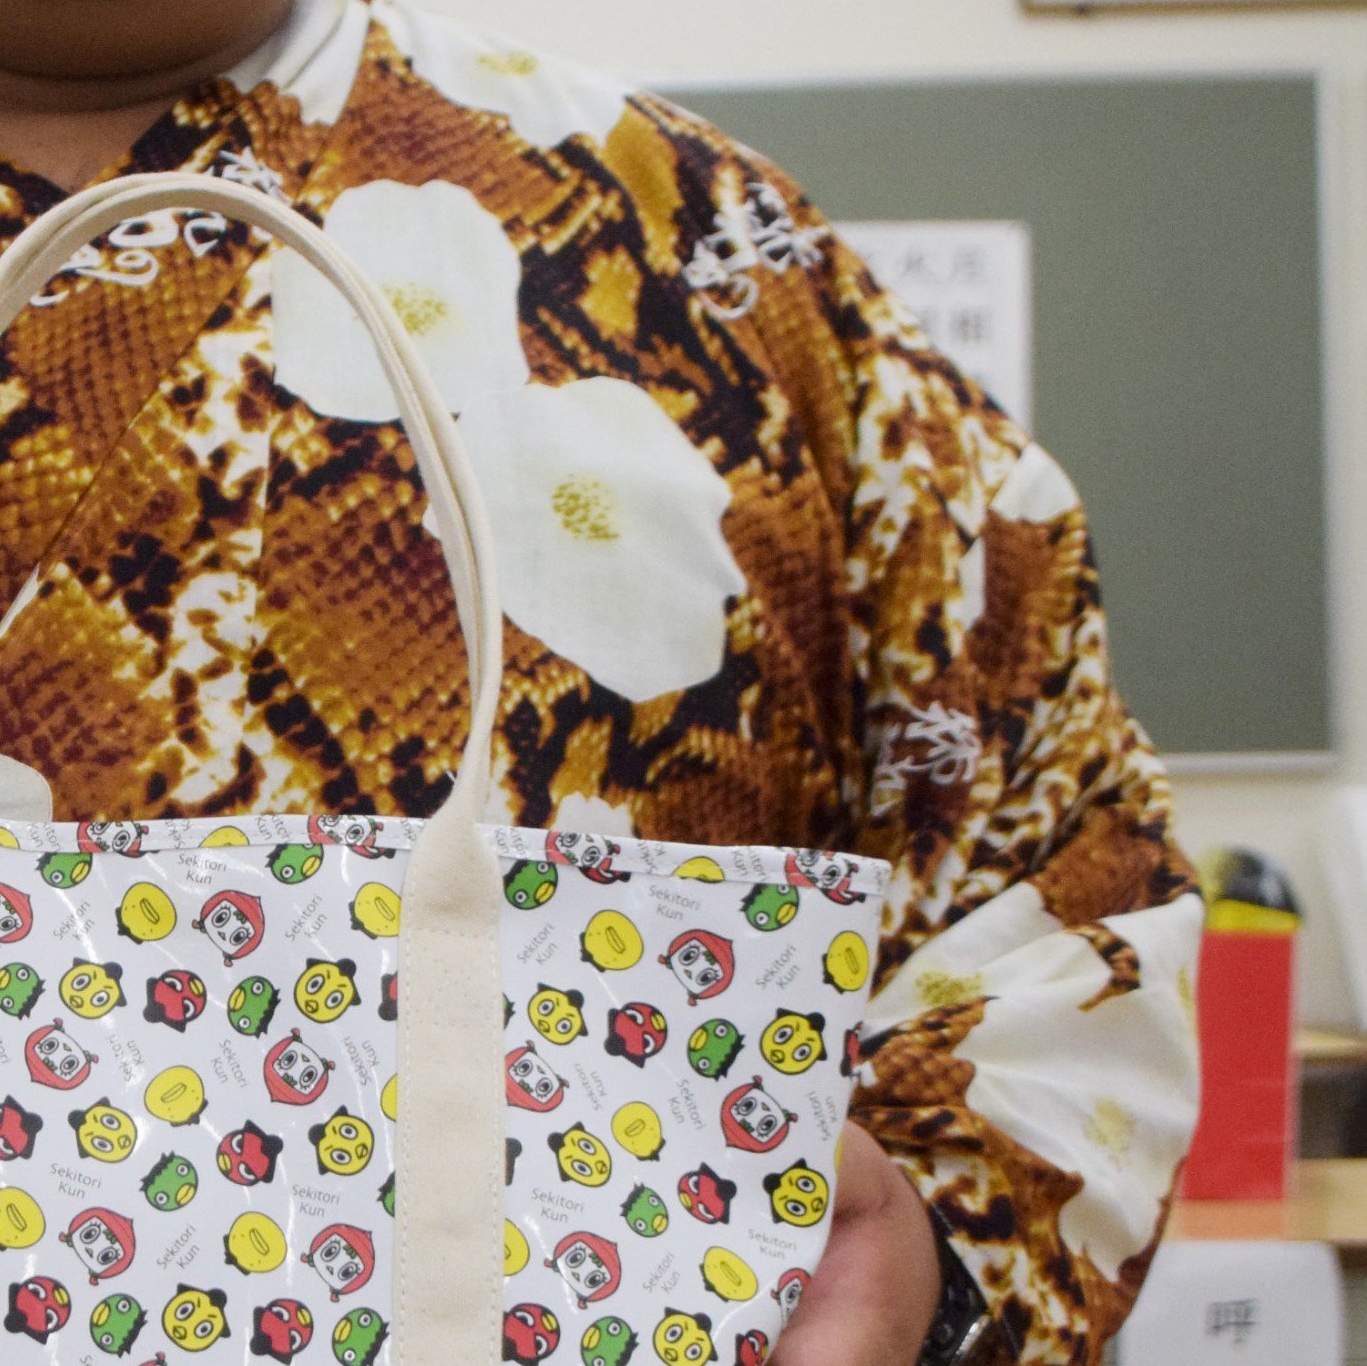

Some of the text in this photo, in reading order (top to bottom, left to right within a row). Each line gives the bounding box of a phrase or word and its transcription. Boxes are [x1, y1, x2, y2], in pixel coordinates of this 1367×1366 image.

[178, 853, 227, 873] Sekitori
[185, 869, 213, 885] Kun
[648, 884, 701, 912] Sekitori
[52, 900, 92, 940] Sekitori
[284, 893, 323, 942] Sekitori
[306, 913, 328, 940] Kun
[656, 905, 684, 922] Kun
[74, 918, 96, 941] Kun
[517, 922, 556, 964] Sekitori
[535, 941, 558, 966] Kun
[755, 943, 798, 989] Sekitori
[775, 963, 802, 990] Kun
[109, 1034, 133, 1082] Sekitori
[128, 1039, 145, 1067] Kun
[218, 1039, 247, 1089] Sekitori
[342, 1035, 372, 1087] Sekitori
[362, 1039, 380, 1069] Kun
[210, 1057, 228, 1084] Kun
[589, 1070, 607, 1097] Kun
[573, 1063, 602, 1111] Sekitori
[669, 1097, 684, 1125] Kun
[676, 1079, 704, 1131] Sekitori
[50, 1162, 103, 1189] Sekitori
[58, 1183, 85, 1200] Kun
[291, 1184, 340, 1205] Sekitori
[530, 1188, 584, 1214] Sekitori
[299, 1203, 326, 1217] Kun
[540, 1207, 569, 1225] Kun
[156, 1223, 197, 1270] Sekitori
[177, 1243, 201, 1270] Kun
[642, 1251, 676, 1294] Sekitori
[661, 1270, 681, 1294] Kun
